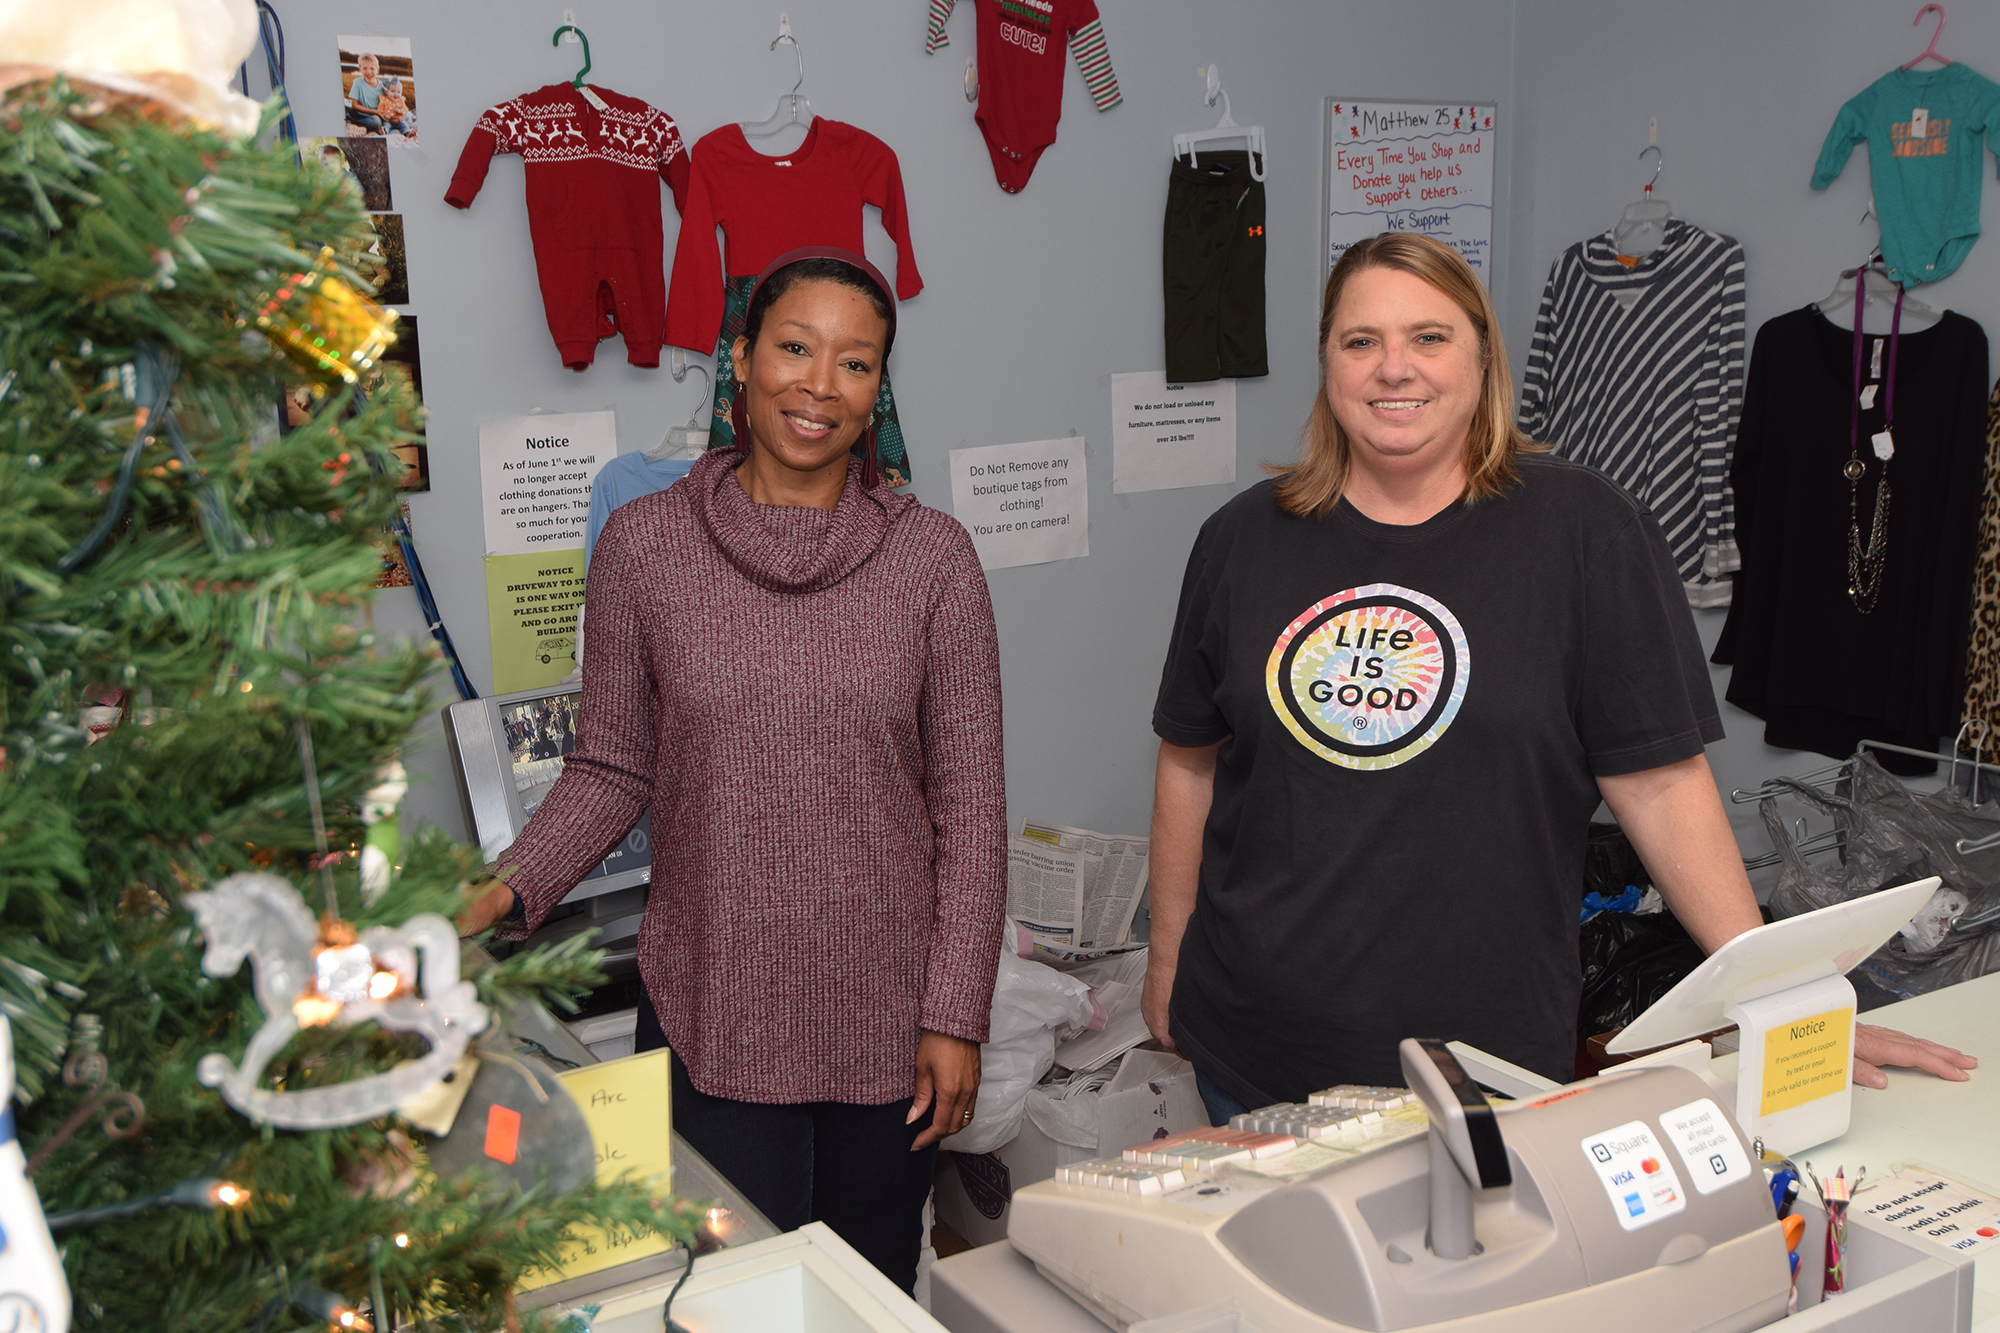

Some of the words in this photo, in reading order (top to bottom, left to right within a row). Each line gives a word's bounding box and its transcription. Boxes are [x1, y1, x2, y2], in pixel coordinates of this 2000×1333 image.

[1363, 110, 1429, 135] Matthew
[1435, 108, 1450, 125] 25
[1337, 150, 1374, 174] Every
[1377, 147, 1404, 165] Time
[1432, 142, 1453, 159] Shop
[1459, 138, 1481, 154] and
[1353, 173, 1391, 189] Donate
[1398, 173, 1416, 189] you
[1420, 167, 1442, 181] help
[1448, 164, 1462, 176] us
[1365, 189, 1411, 207] Support
[1386, 213, 1405, 230] We
[1409, 211, 1450, 231] Support
[526, 436, 569, 450] Notice
[503, 462, 514, 470] As
[516, 460, 526, 470] of
[528, 460, 548, 468] June
[551, 458, 561, 467] 1st
[579, 455, 595, 464] will
[970, 466, 984, 476] Do
[987, 464, 1006, 474] Not
[1009, 460, 1049, 472] Remove
[1052, 459, 1068, 469] any
[528, 474, 556, 484] longer
[559, 472, 587, 481] accept
[973, 483, 1018, 495] boutique
[1021, 480, 1042, 491] tags
[1045, 477, 1067, 487] from
[499, 491, 536, 500] clothing
[538, 487, 582, 497] donations
[532, 503, 570, 513] hangers.
[572, 500, 590, 509] Tha
[1000, 497, 1044, 512] clothing!
[516, 521, 526, 529] so
[529, 517, 553, 527] much
[555, 516, 568, 525] for
[974, 525, 992, 535] You
[996, 523, 1012, 533] are
[1031, 514, 1070, 528] camera!
[526, 530, 582, 542] cooperation.
[538, 567, 574, 577] NOTICE
[507, 581, 558, 592] DRIVEWAY
[527, 594, 547, 602] ONE
[549, 592, 570, 600] WAY
[514, 606, 549, 616] PLEASE
[551, 604, 574, 612] EXIT
[521, 619, 541, 627] AND
[537, 626, 576, 636] BUILDIN
[1350, 656, 1384, 679] IS
[1309, 680, 1417, 711] GOOD
[1013, 849, 1030, 857] order
[1031, 853, 1053, 865] barring
[1031, 861, 1055, 871] vaccine
[1790, 1020, 1825, 1041] Notice
[1780, 1056, 1790, 1064] you
[1791, 1047, 1813, 1060] received
[1818, 1041, 1837, 1052] coupon
[1794, 1065, 1804, 1074] text
[1812, 1058, 1825, 1068] email
[1777, 1084, 1788, 1094] only
[1789, 1081, 1801, 1090] valid
[1821, 1071, 1833, 1080] time
[1834, 1068, 1843, 1076] use
[1674, 1121, 1688, 1130] We
[1689, 1111, 1711, 1126] accept
[1687, 1131, 1696, 1140] all
[1695, 1125, 1714, 1137] major
[1609, 1133, 1649, 1155] Square
[1688, 1141, 1708, 1155] credit
[1610, 1170, 1635, 1186] VISA
[1875, 1203, 1892, 1211] do
[1891, 1195, 1913, 1206] not
[1911, 1181, 1948, 1197] accept
[1885, 1205, 1925, 1222] checks
[1902, 1216, 1943, 1232] redit,
[1942, 1210, 1951, 1218] &
[1947, 1199, 1983, 1213] Debit
[1928, 1223, 1959, 1236] Only
[1950, 1238, 1979, 1250] VISA
